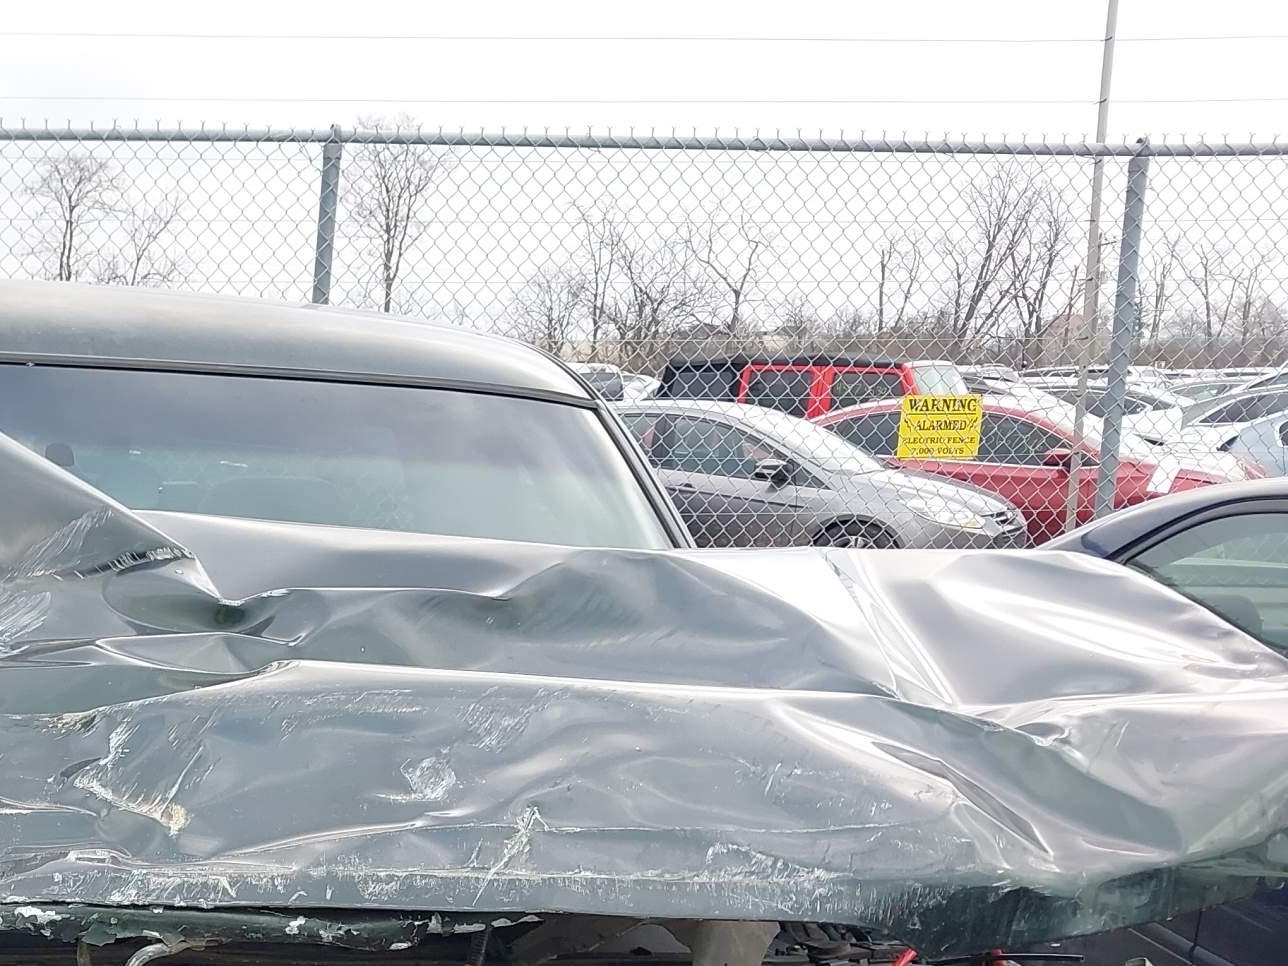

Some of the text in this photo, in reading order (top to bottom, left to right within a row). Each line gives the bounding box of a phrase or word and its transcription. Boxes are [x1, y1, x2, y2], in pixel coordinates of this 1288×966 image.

[908, 398, 977, 412] WARNING
[917, 420, 967, 431] ALARMED
[937, 447, 964, 455] VOLTS
